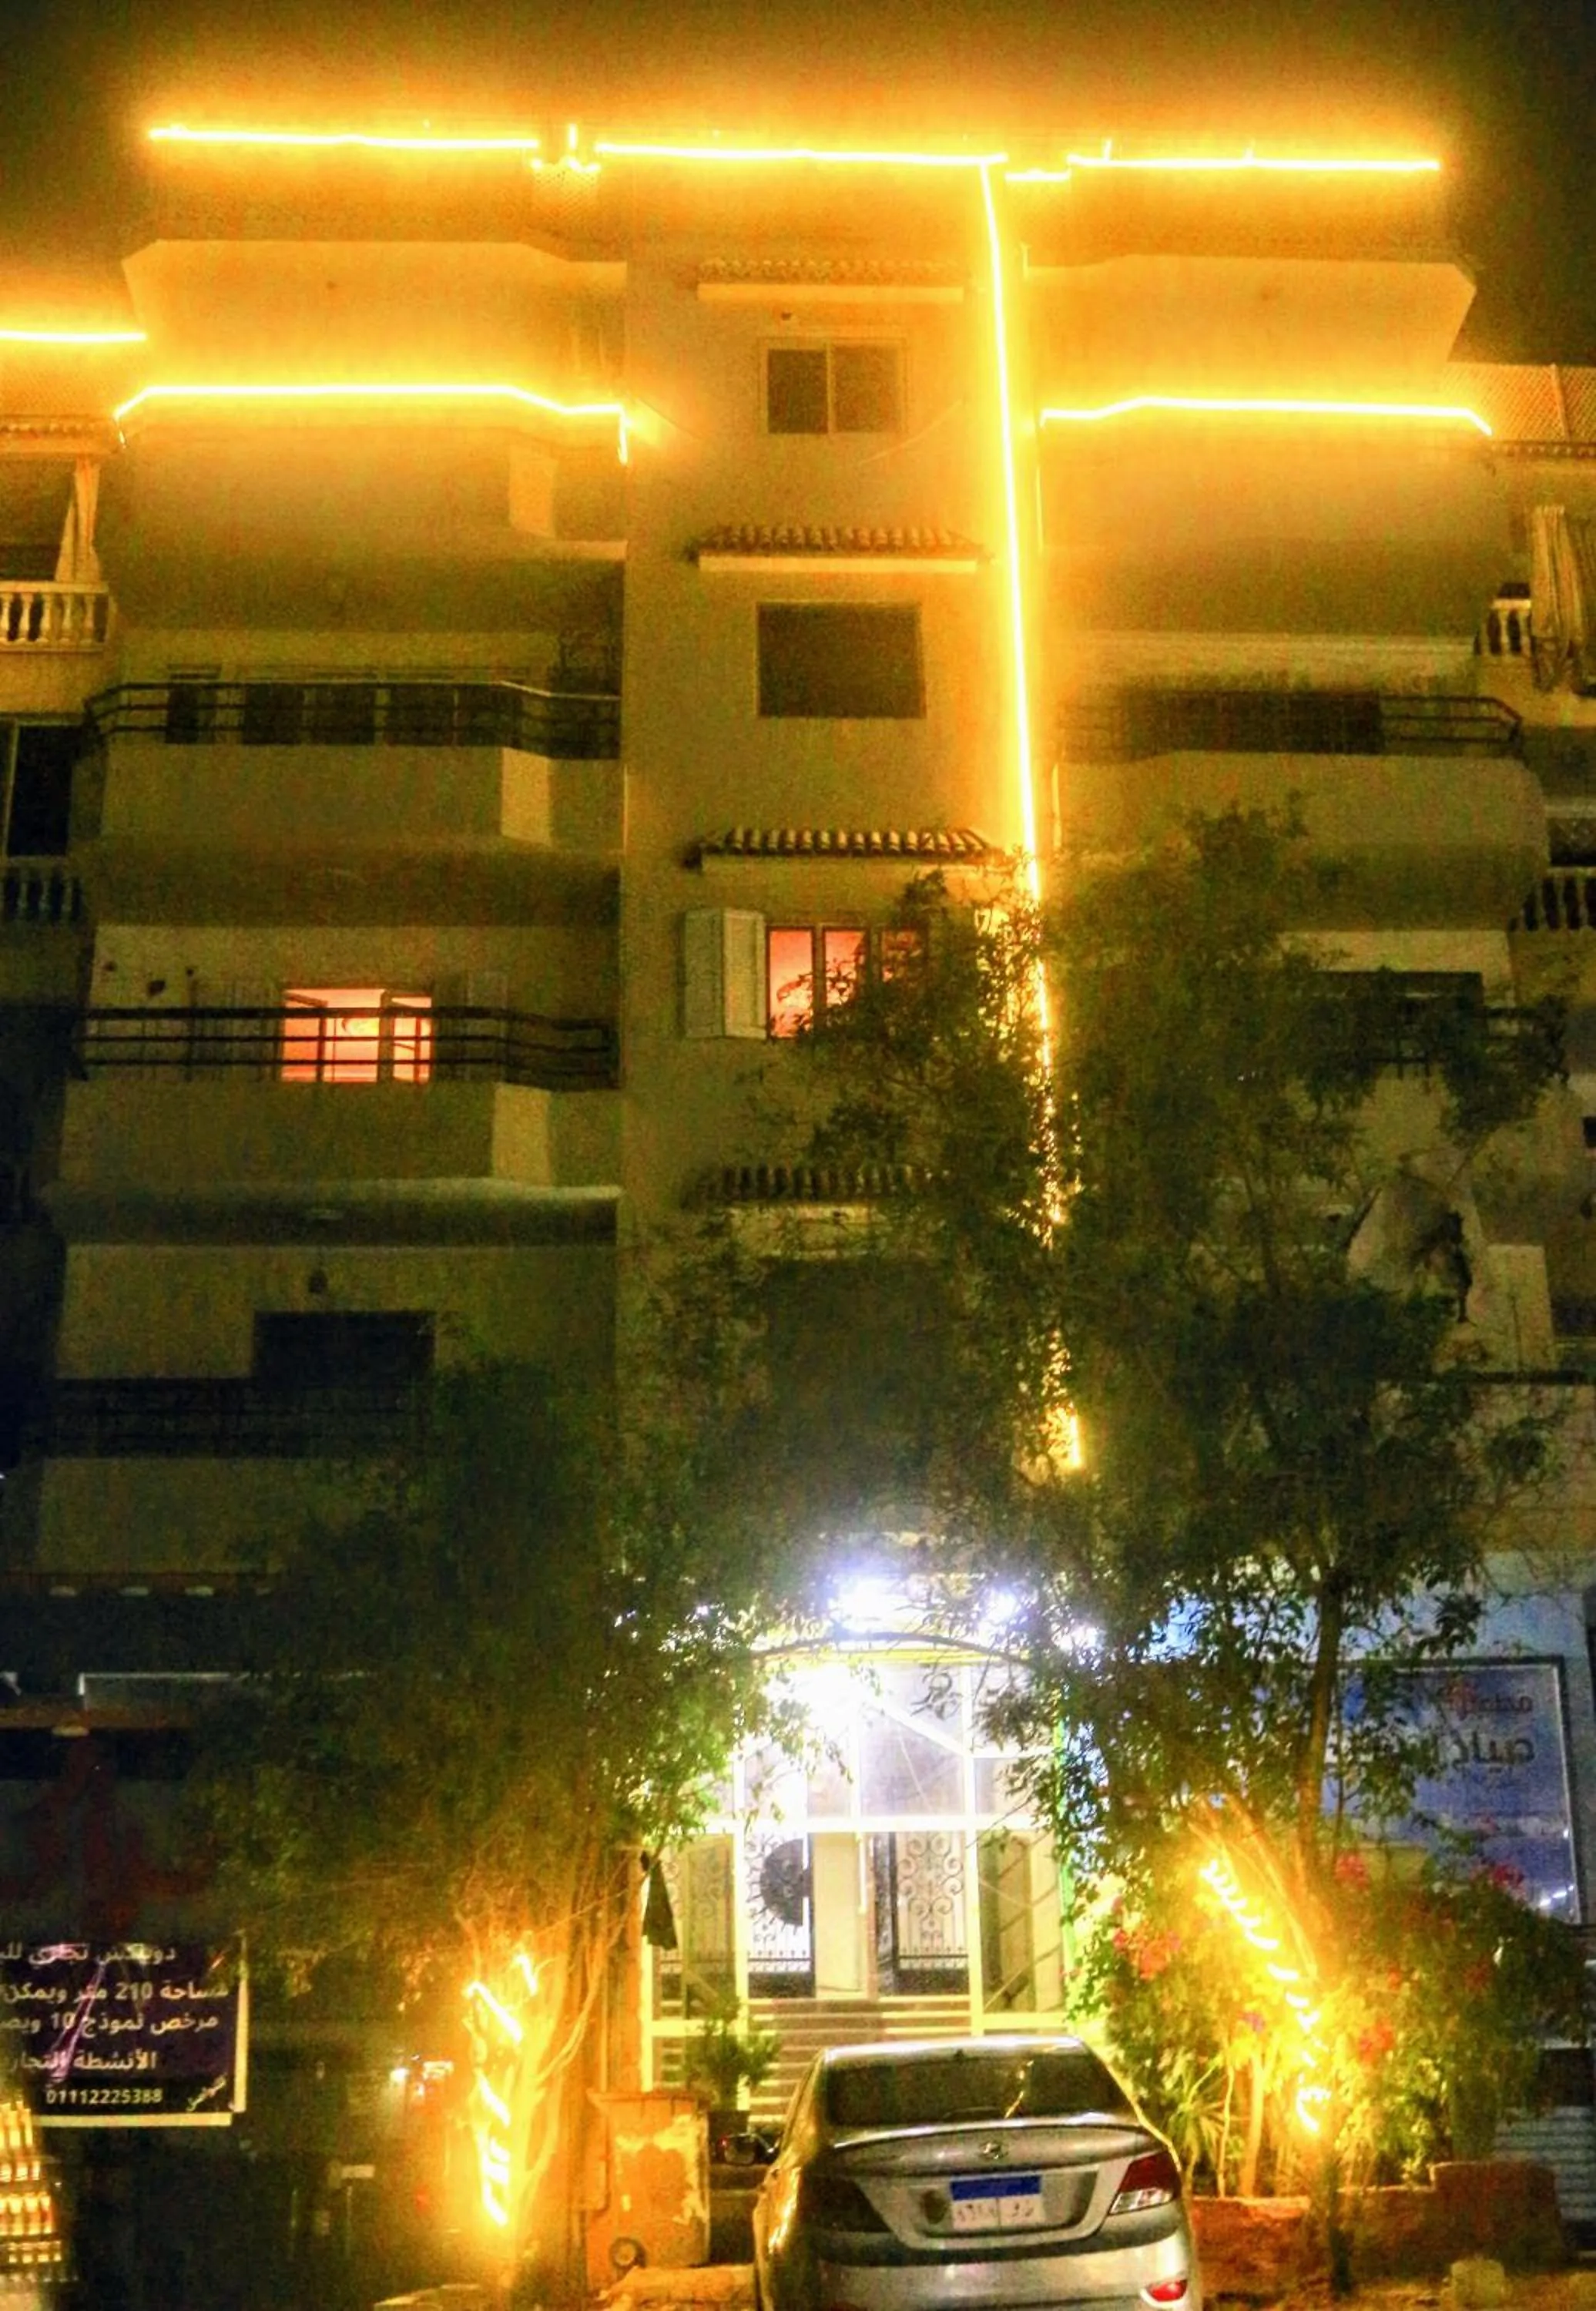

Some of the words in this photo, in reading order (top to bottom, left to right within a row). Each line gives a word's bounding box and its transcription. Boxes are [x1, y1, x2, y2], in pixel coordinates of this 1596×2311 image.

[115, 1981, 153, 2001] 210
[51, 2011, 76, 2031] 10
[81, 2013, 145, 2038] نموذج
[150, 2011, 219, 2034] مرخص
[72, 2047, 157, 2071] الأنشطة
